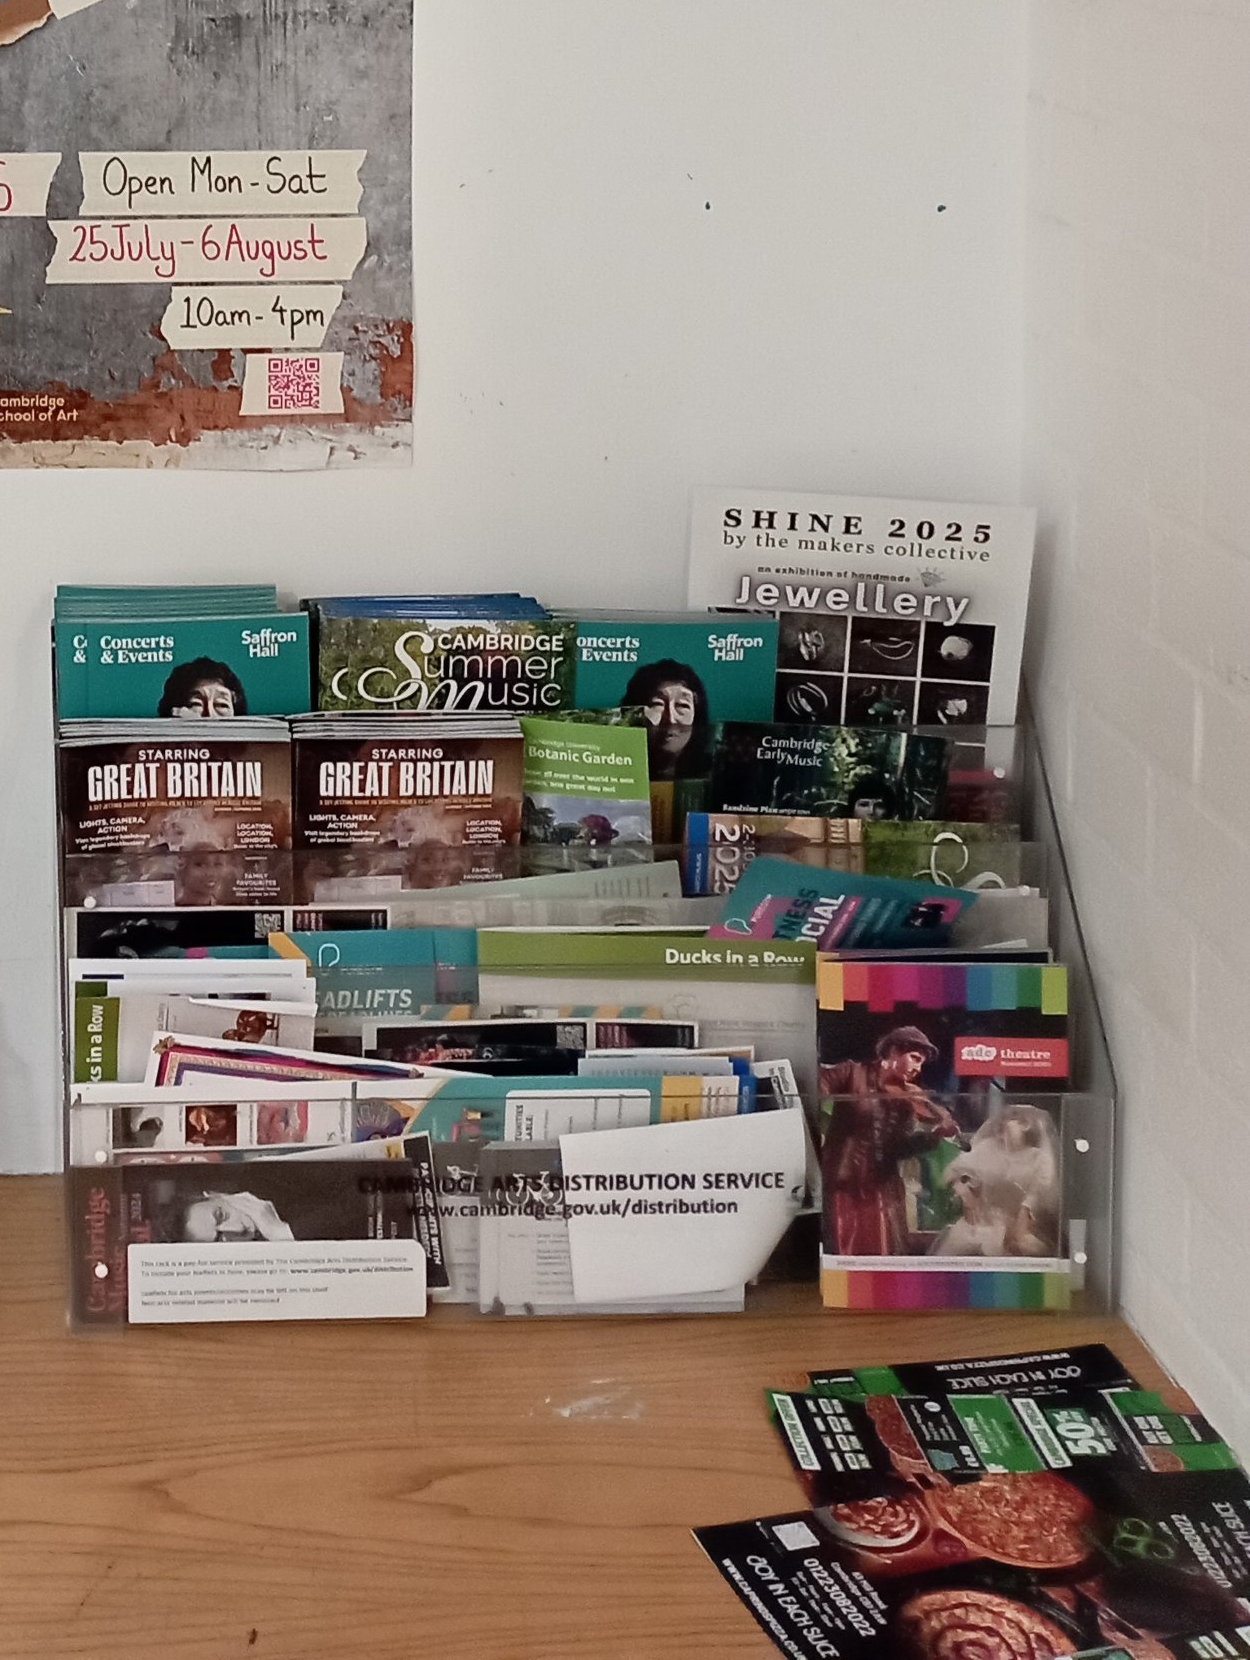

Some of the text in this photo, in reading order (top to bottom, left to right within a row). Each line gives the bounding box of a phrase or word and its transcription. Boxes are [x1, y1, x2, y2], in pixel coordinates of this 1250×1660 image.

[103, 157, 175, 209] Open
[56, 408, 79, 422] Art
[723, 508, 992, 544] SHINE 2025
[723, 530, 991, 562] by the makers collective
[736, 575, 969, 627] Jewellery
[100, 628, 297, 650] Concerts Saffron
[438, 633, 564, 651] CAMBRIDGE
[708, 633, 763, 649] Saffron
[100, 644, 278, 664] & Events Hall
[582, 647, 744, 662] Events Hall
[394, 678, 561, 711] Music
[139, 748, 210, 761] STARRING
[372, 748, 443, 760] STARRING
[762, 736, 829, 754] Cambridge
[529, 746, 632, 766] Botanic Garden
[88, 761, 262, 802] GREAT BRITAIN
[319, 760, 494, 797] GREAT BRITAIN
[795, 894, 846, 942] CIAL
[665, 948, 743, 964] Ducks in
[317, 989, 412, 1009] ADLIFTS
[87, 1005, 104, 1032] Row
[1000, 1049, 1051, 1059] theatre
[554, 1172, 785, 1191] DISTRIBUTION SERVICE
[803, 1558, 876, 1637] 01223082022
